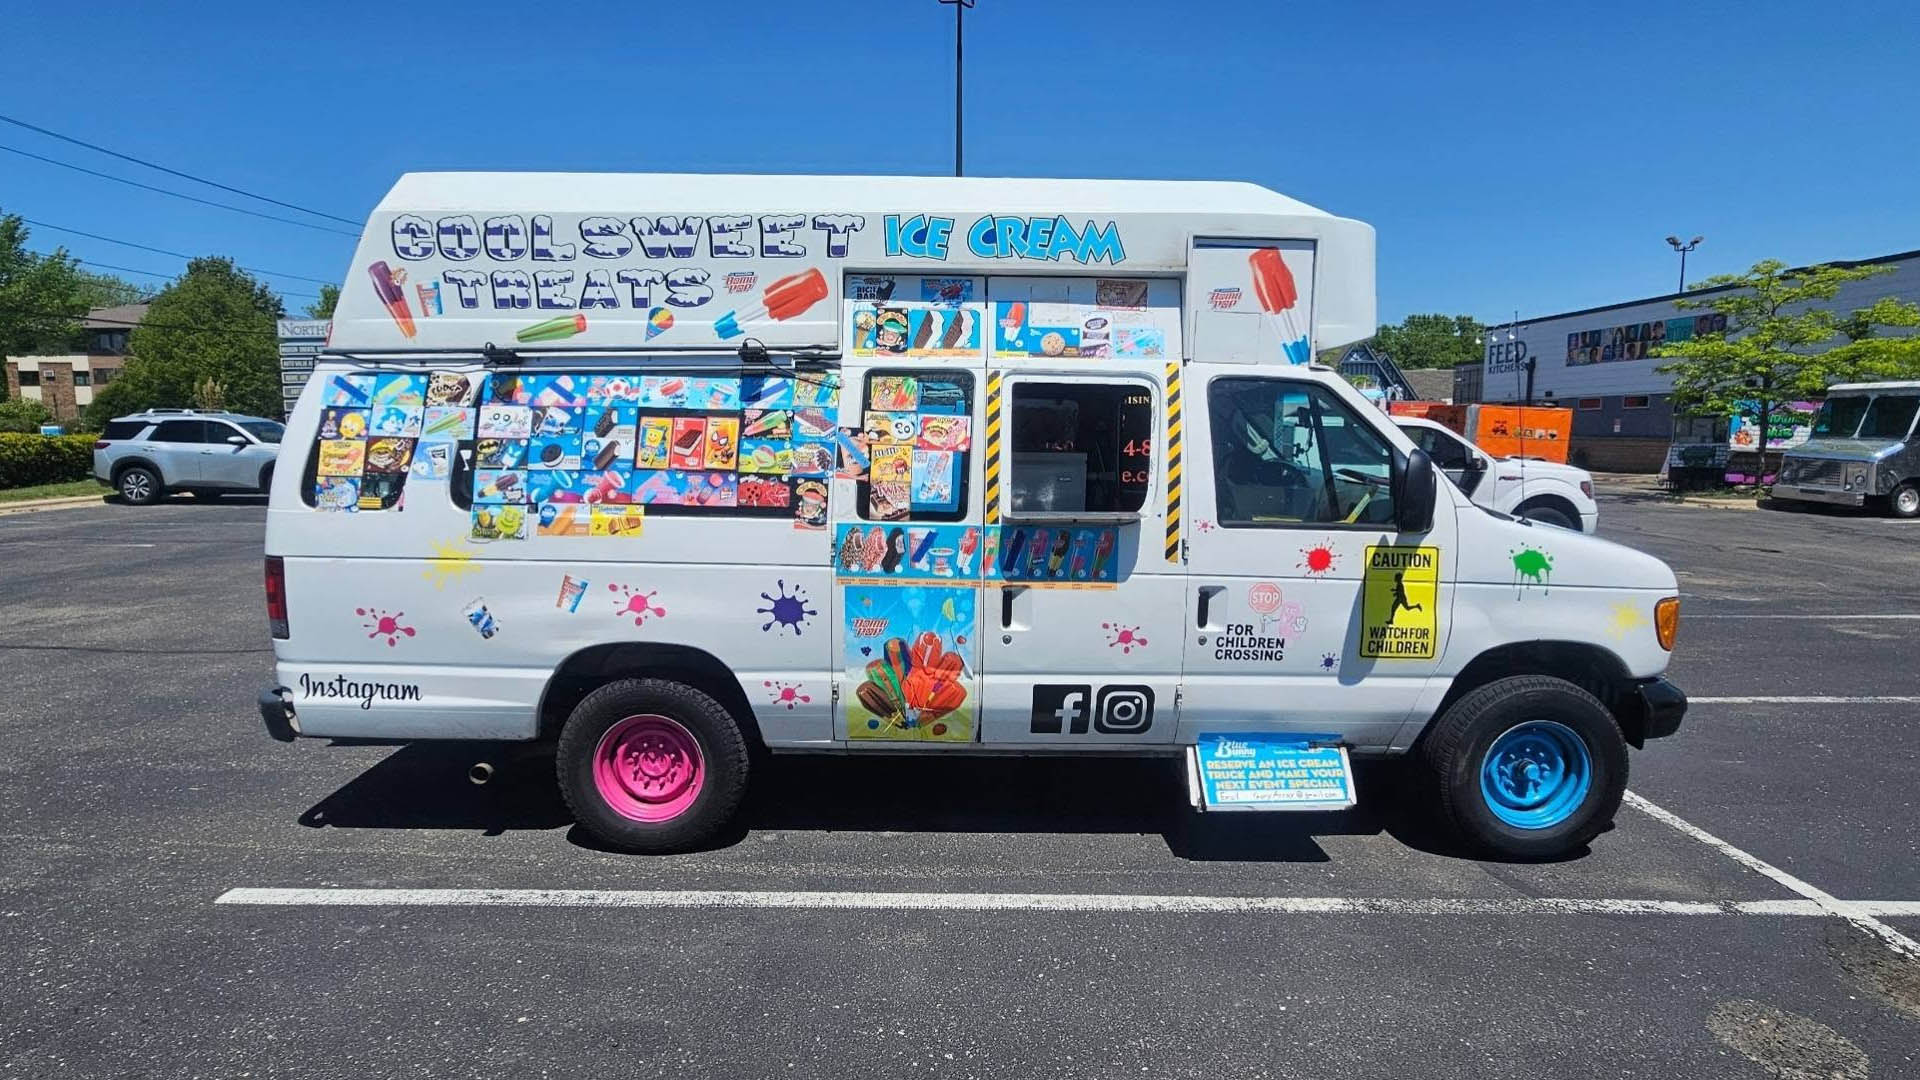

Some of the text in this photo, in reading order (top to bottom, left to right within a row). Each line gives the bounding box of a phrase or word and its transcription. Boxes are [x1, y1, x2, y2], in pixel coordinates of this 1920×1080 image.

[884, 213, 1127, 265] ICE CREAM
[442, 268, 714, 309] TREATS
[1488, 341, 1527, 365] FEED
[1122, 470, 1150, 483] e.c
[1372, 552, 1431, 568] CAUTION
[1252, 592, 1280, 604] STOP
[1226, 624, 1254, 636] FOR
[1369, 627, 1429, 640] WATCH FOR
[1216, 637, 1285, 649] CHILDREN
[1367, 641, 1429, 654] CHILDREN
[1215, 649, 1284, 661] CROSSING
[300, 673, 422, 709] Instagram
[1207, 760, 1339, 769] RESERVE AN ICE CREAM
[1209, 769, 1344, 780] TRUCK AND MAKE YOUR
[1216, 781, 1245, 790] NEXT
[1249, 780, 1284, 789] EVENT
